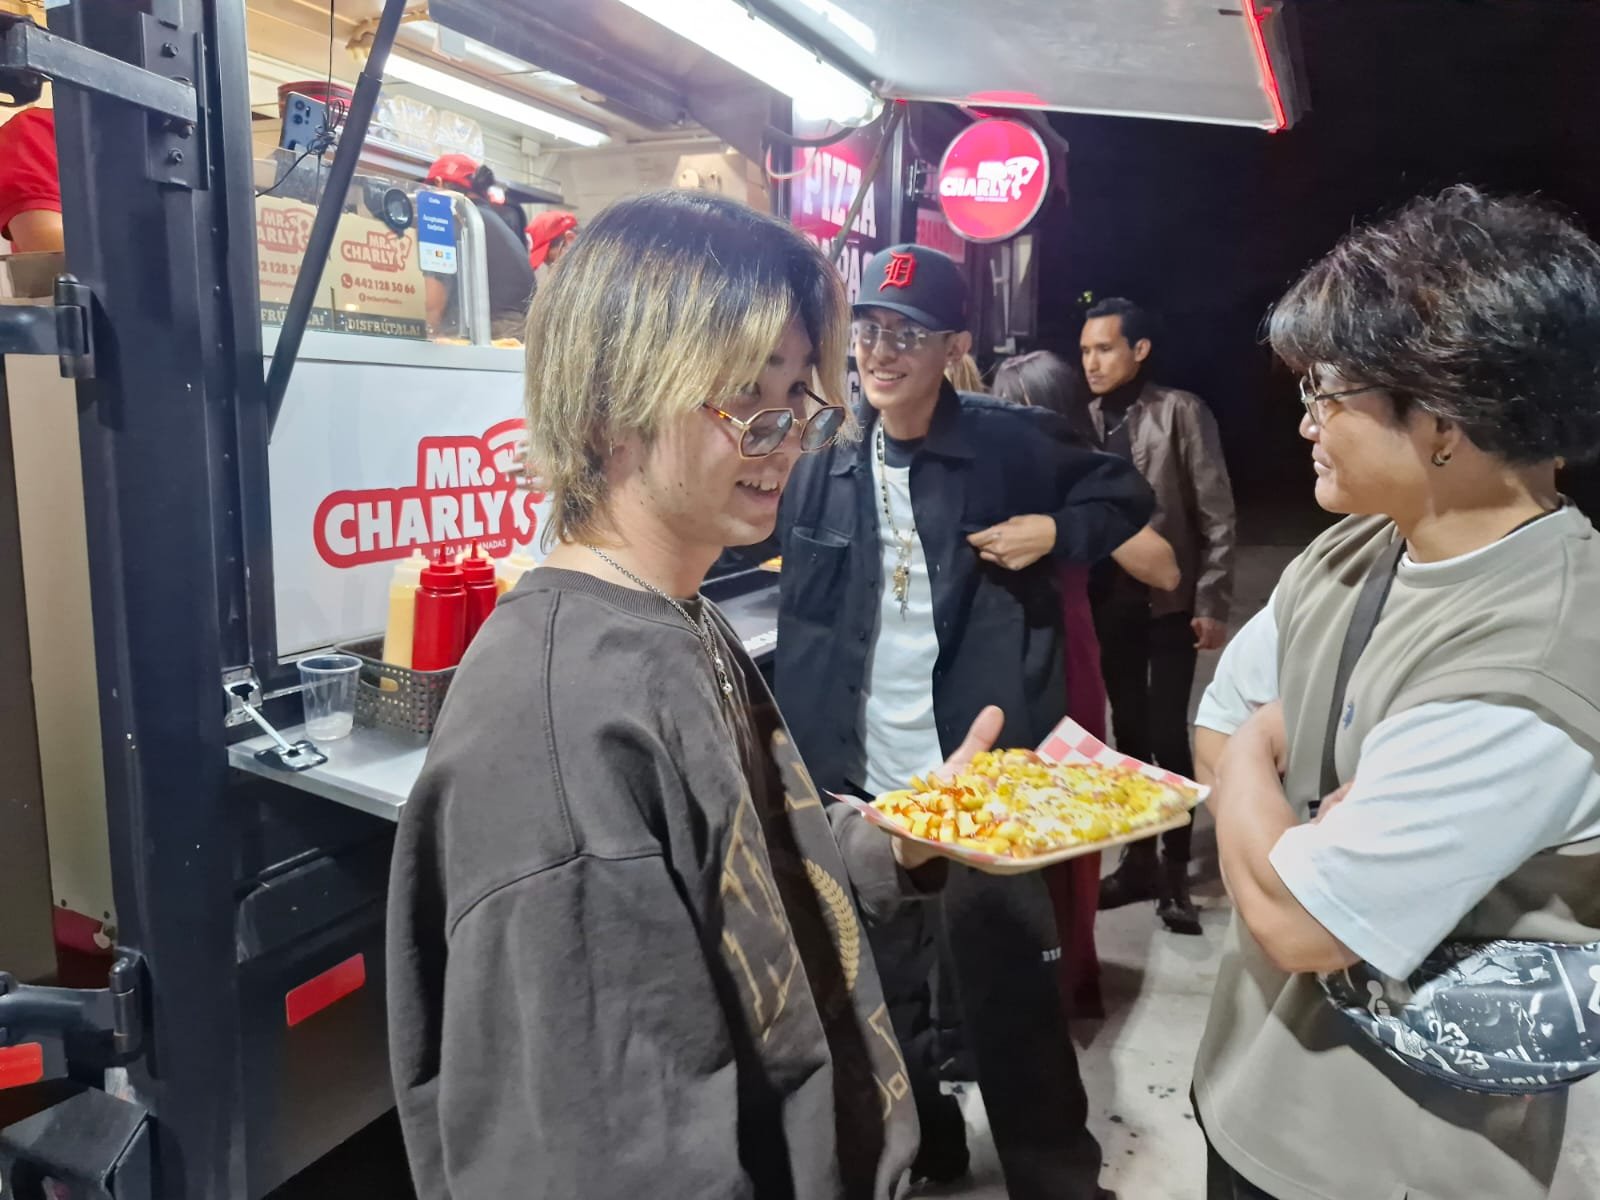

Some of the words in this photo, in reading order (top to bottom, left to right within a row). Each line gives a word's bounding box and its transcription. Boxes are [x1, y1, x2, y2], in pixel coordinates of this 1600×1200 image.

[803, 147, 877, 239] PIZZA
[425, 446, 496, 491] MR.
[1429, 1019, 1470, 1047] 23
